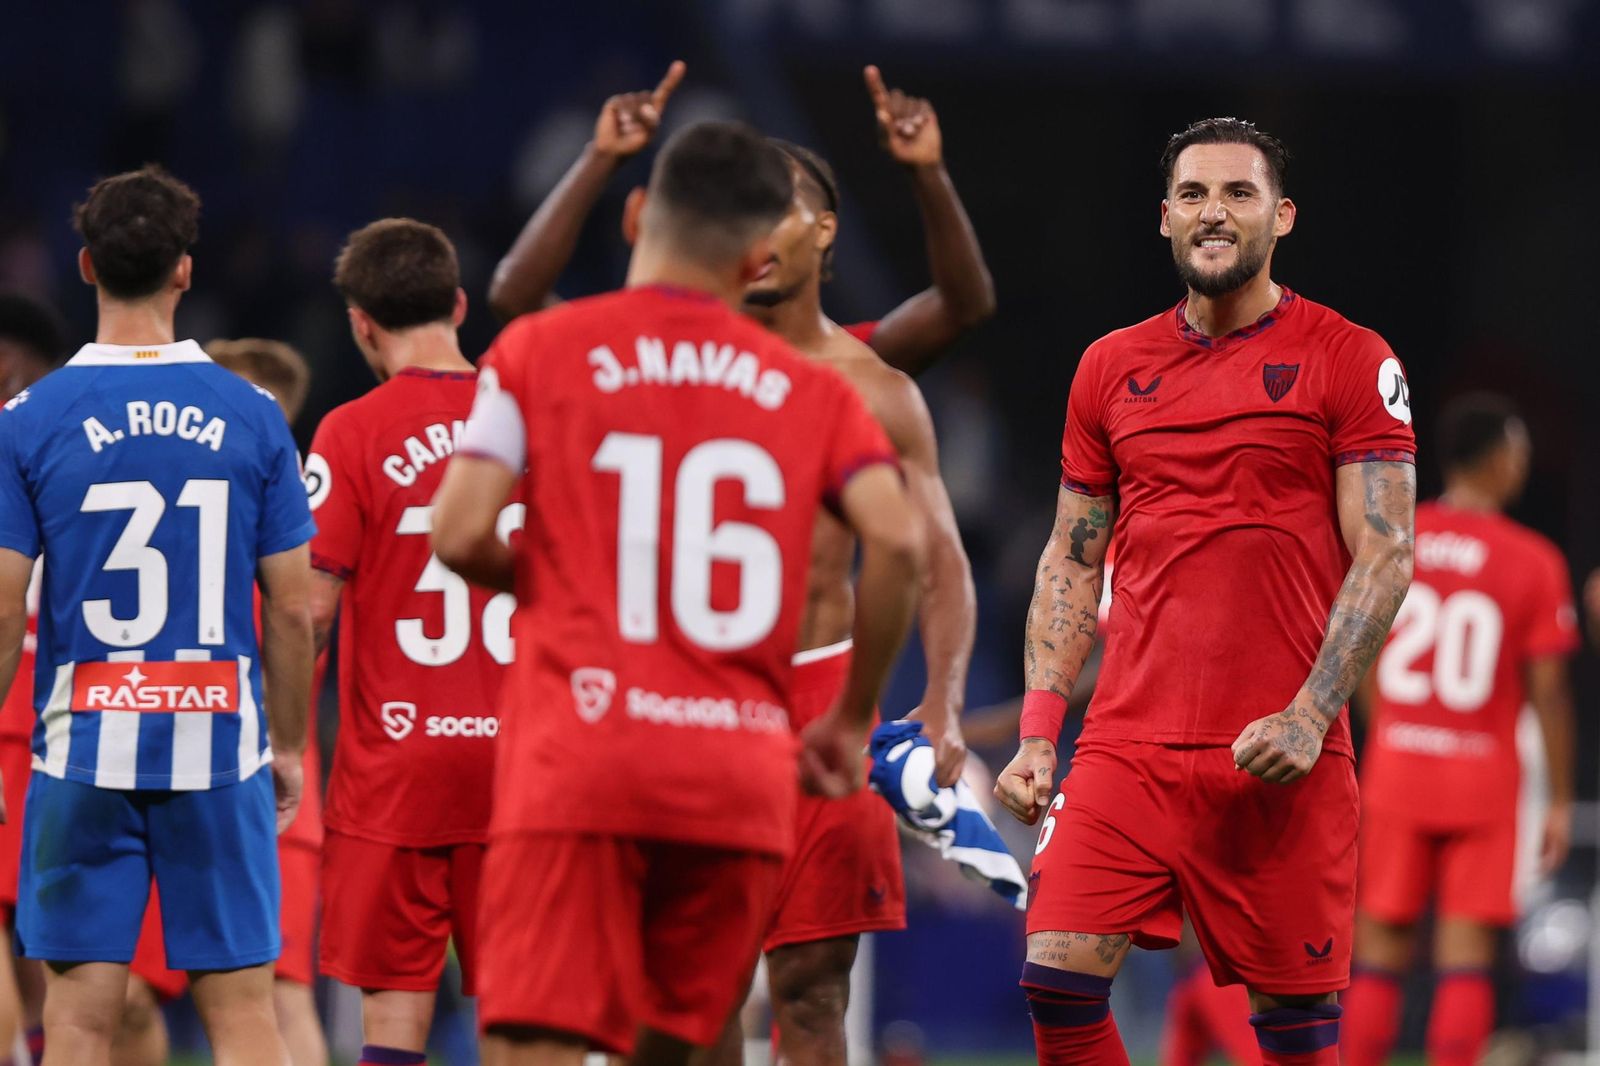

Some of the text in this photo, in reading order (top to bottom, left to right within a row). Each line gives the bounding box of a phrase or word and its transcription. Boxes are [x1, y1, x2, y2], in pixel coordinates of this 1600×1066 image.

[588, 335, 792, 410] J.NAVAS
[82, 401, 226, 453] A. ROCA
[79, 479, 230, 648] 31
[593, 432, 786, 650] 16
[1376, 580, 1504, 713] 20
[86, 685, 229, 709] RASTAR
[425, 716, 502, 738] SOCIO
[1035, 793, 1065, 855] 6
